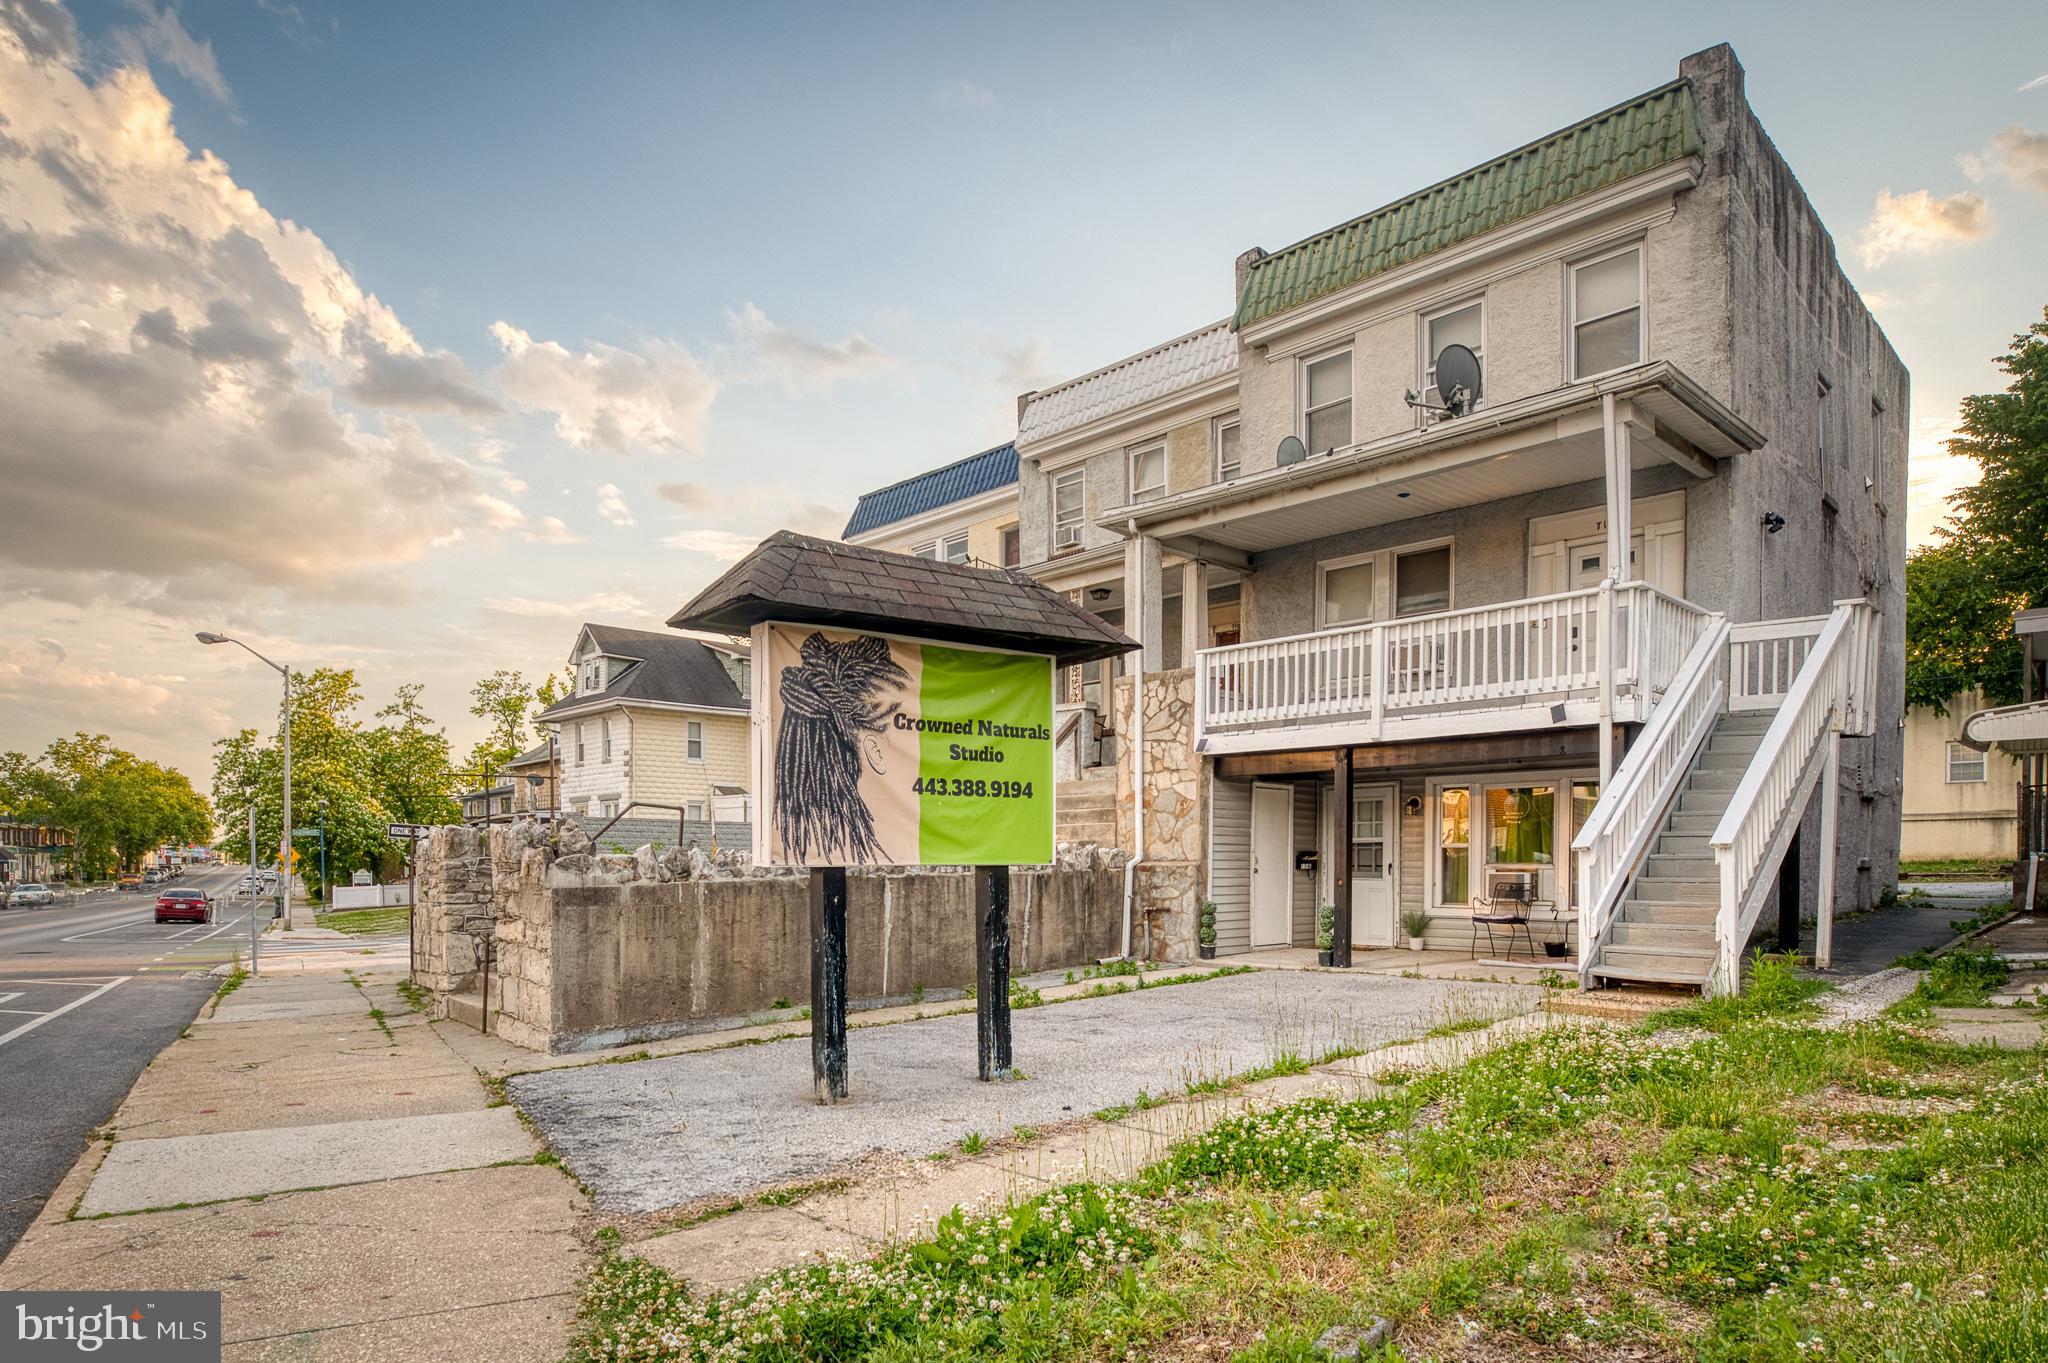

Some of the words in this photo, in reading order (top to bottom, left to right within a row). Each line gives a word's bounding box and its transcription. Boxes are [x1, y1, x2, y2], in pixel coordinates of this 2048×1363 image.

[893, 712, 974, 735] Crowned
[977, 719, 1051, 740] Naturals
[949, 743, 1005, 763] Studio
[912, 777, 1034, 799] 443.388.9194
